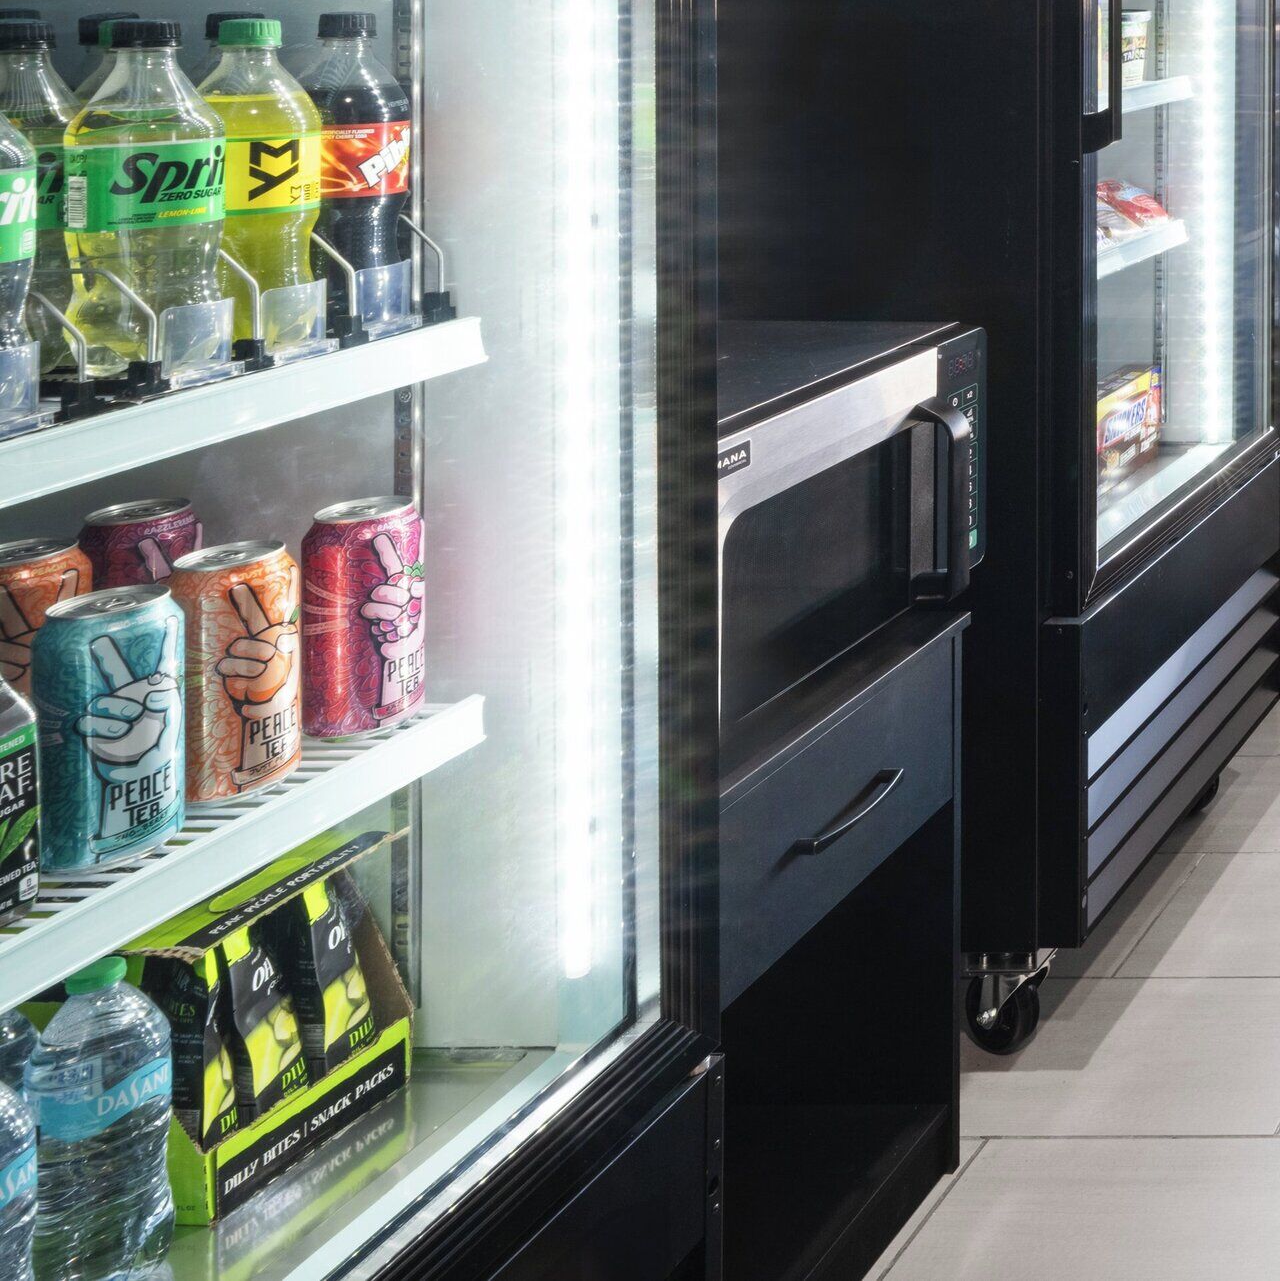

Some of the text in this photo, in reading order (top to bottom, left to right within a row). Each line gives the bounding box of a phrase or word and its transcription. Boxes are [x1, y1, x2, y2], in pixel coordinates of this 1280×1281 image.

[158, 188, 222, 203] ZERO SUGAR
[249, 703, 296, 745] PEACE
[109, 758, 172, 811] PEACE
[122, 799, 163, 827] TEA
[208, 845, 359, 935] PEAK PICKLE PORTABILITY
[97, 1062, 169, 1117] DASANI
[223, 1062, 395, 1196] DILLY BITES SNACK PACKS
